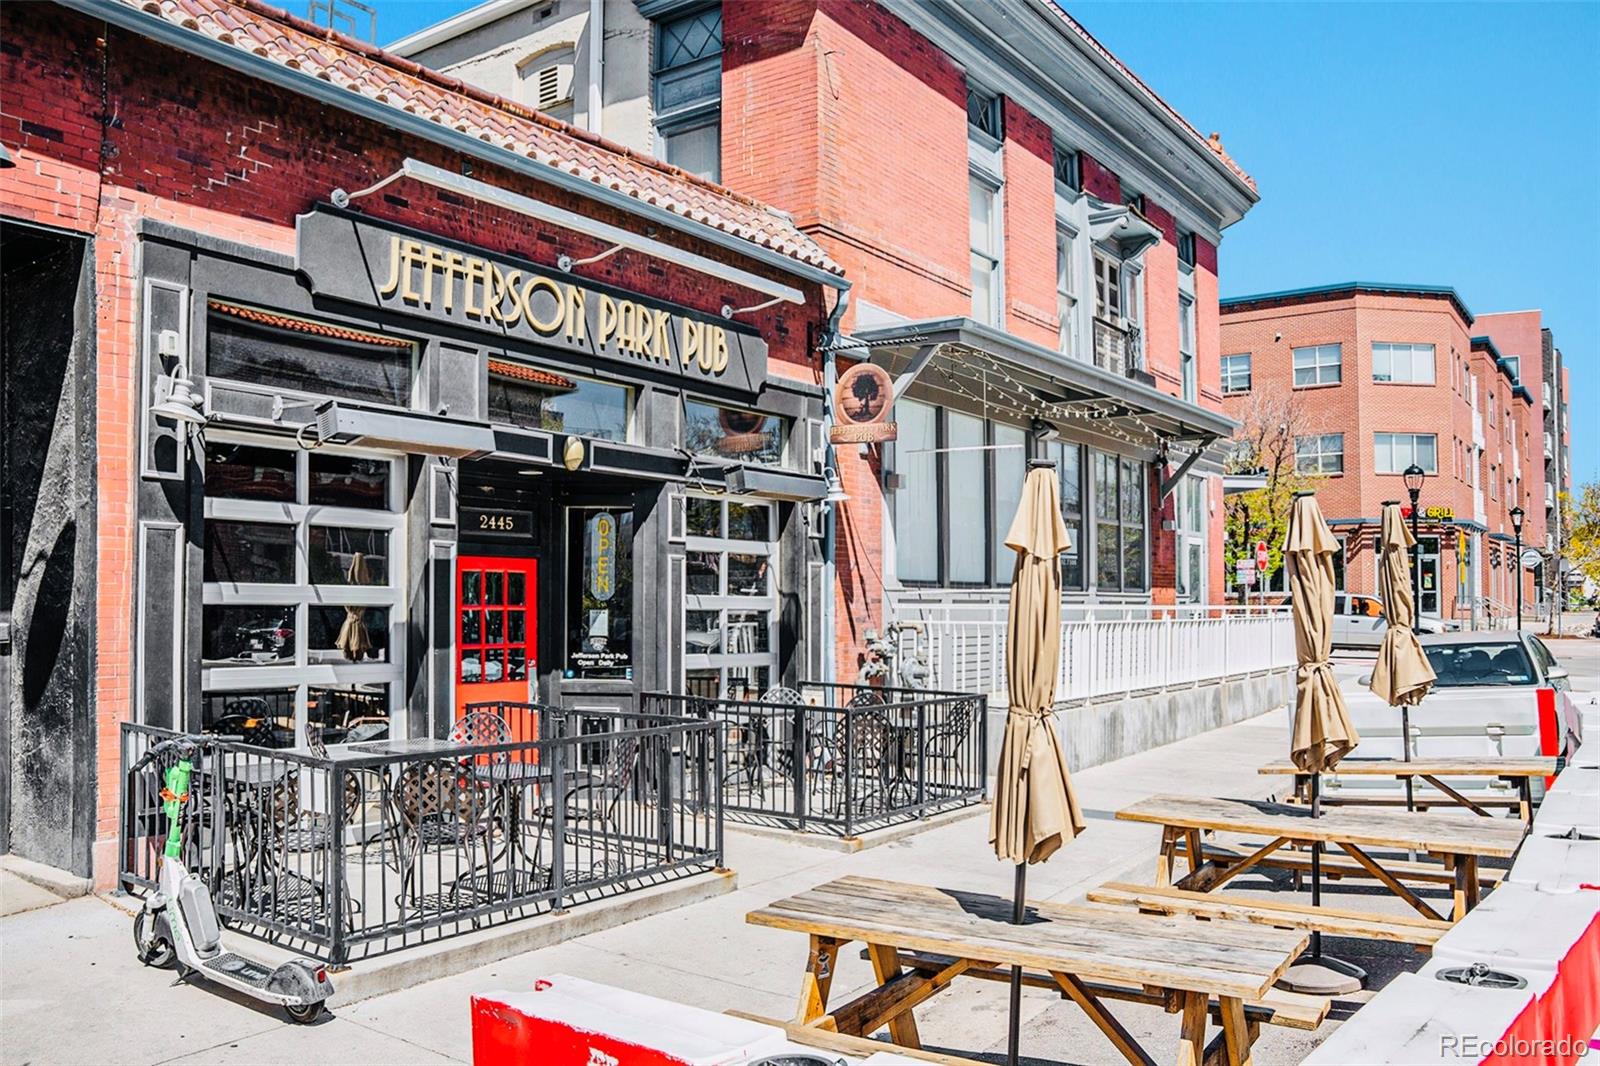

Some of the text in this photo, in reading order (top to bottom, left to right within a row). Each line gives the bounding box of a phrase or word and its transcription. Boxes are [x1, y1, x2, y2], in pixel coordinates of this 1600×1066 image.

[380, 236, 729, 373] JEFFERSON PARK PUB
[479, 514, 514, 530] 2445
[597, 518, 609, 593] OPEN
[598, 659, 615, 668] Daily
[615, 652, 629, 660] Pub
